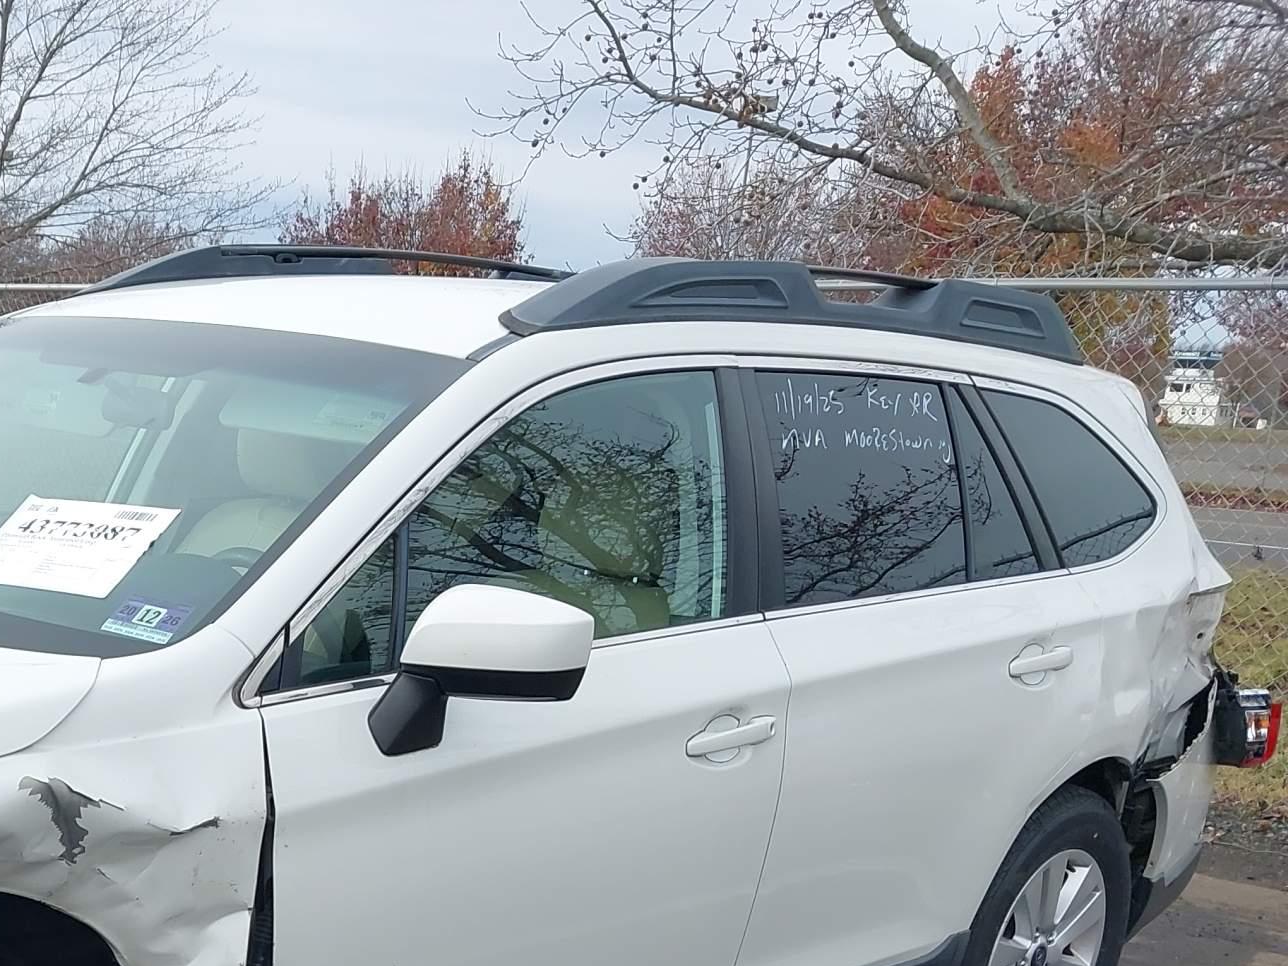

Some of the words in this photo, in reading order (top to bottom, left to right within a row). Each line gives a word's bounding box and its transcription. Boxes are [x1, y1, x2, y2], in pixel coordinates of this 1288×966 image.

[775, 378, 844, 420] 11/19/25
[18, 518, 143, 541] 43773087
[119, 604, 137, 616] 20
[136, 608, 162, 625] 12
[160, 615, 181, 626] 26
